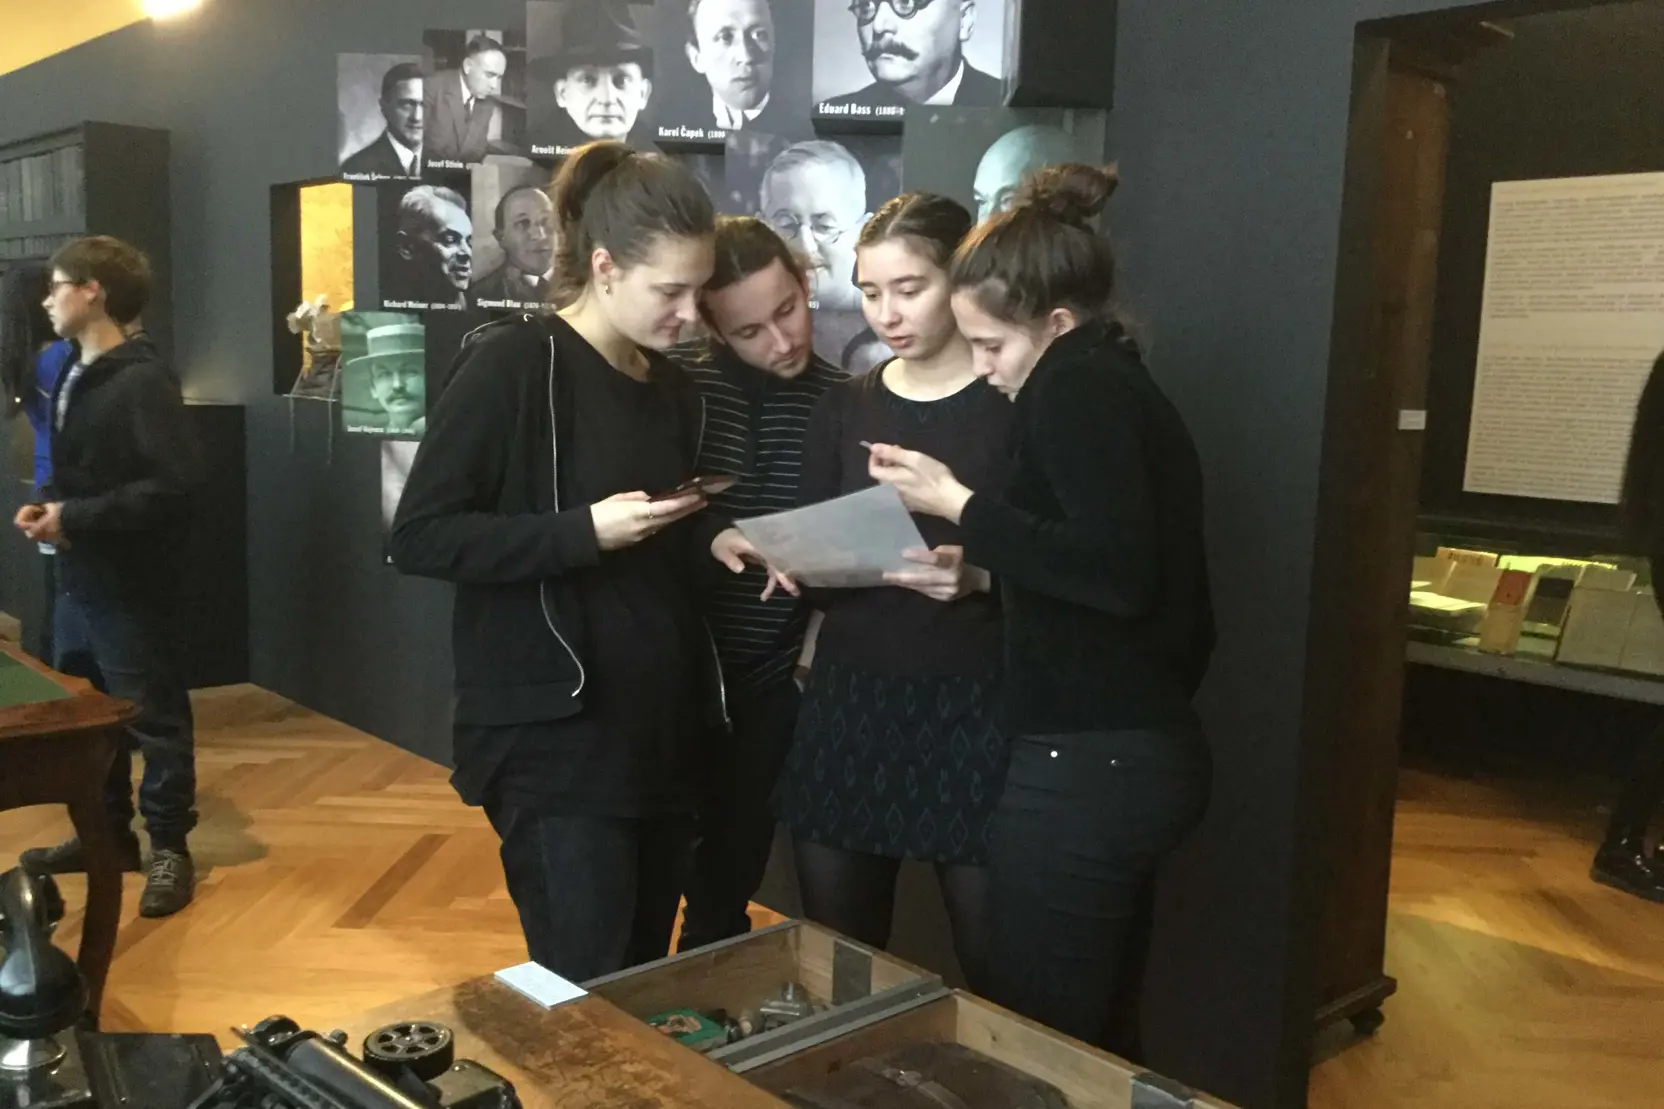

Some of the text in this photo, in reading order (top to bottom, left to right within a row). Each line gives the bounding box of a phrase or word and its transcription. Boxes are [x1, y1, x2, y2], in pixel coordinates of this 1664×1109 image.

[819, 102, 849, 115] Eduard
[850, 103, 872, 115] Bass
[658, 126, 680, 137] Karel
[680, 125, 705, 140] Čapek
